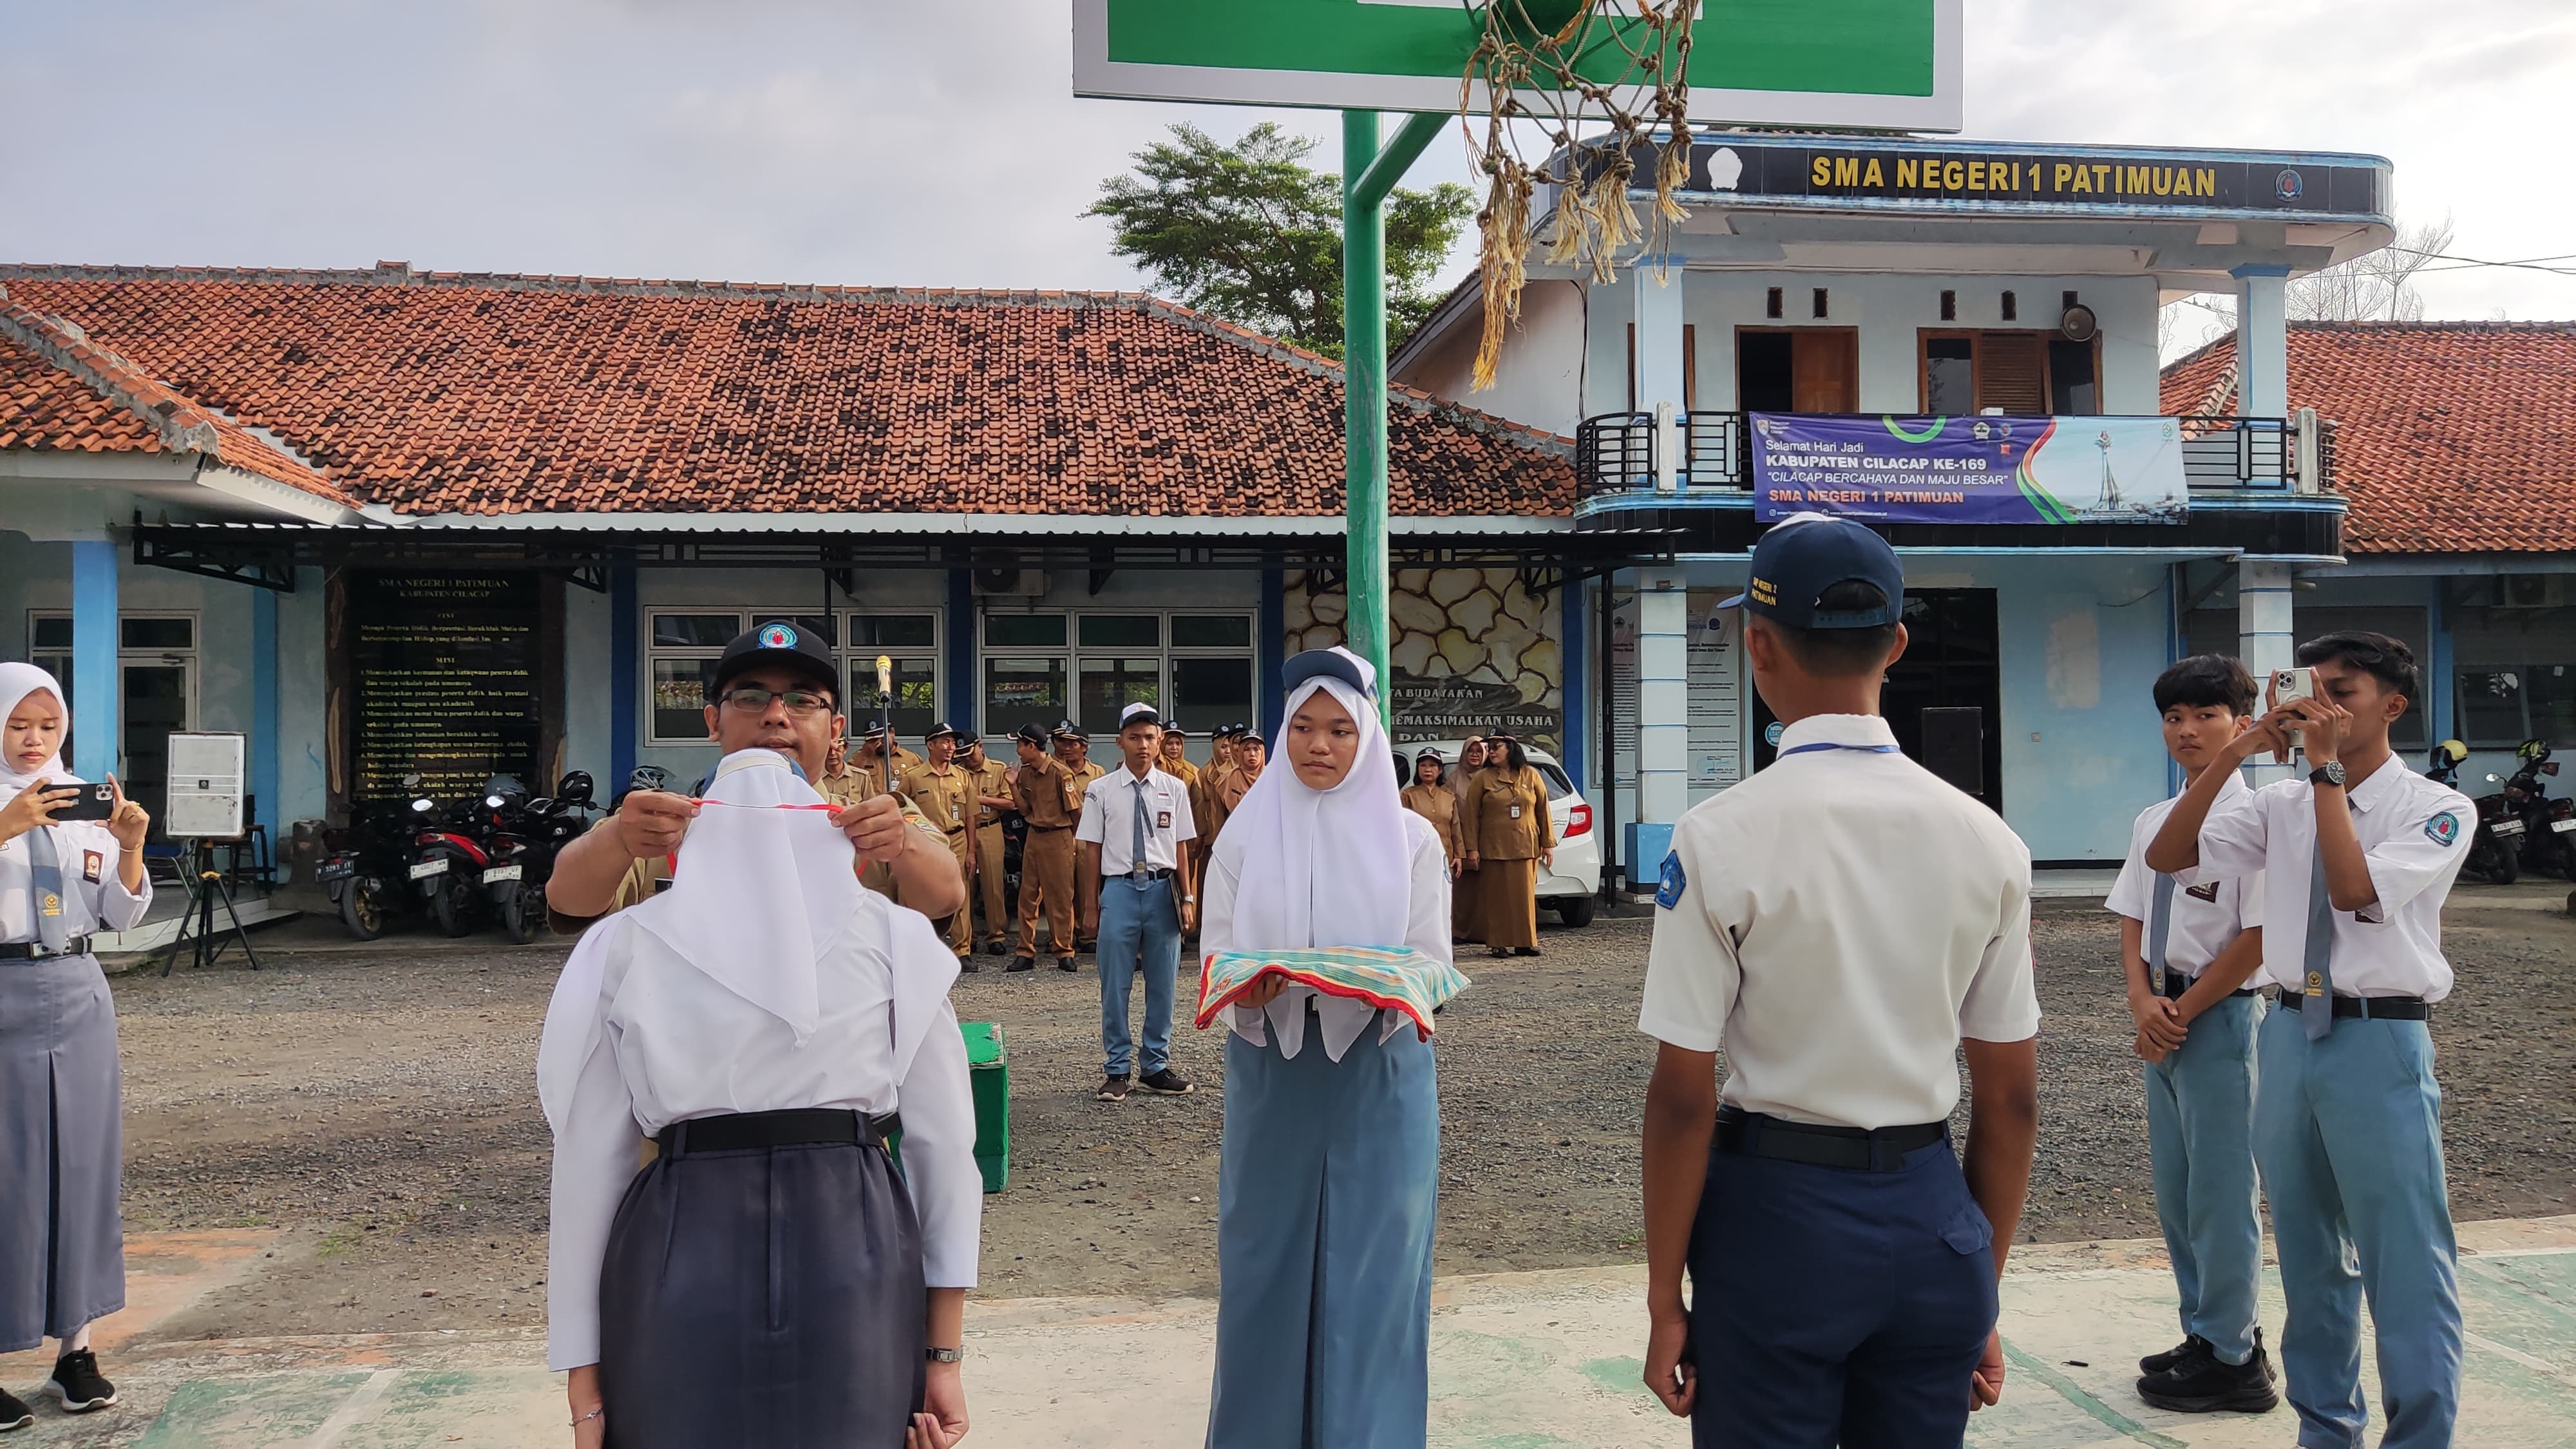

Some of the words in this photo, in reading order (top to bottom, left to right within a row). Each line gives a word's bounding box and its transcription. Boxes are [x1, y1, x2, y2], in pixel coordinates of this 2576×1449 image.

[1812, 156, 1884, 187] SMA
[1897, 159, 2020, 191] NEGERI
[2029, 164, 2040, 191] 1
[2054, 164, 2215, 196] PATIMUAN
[1766, 440, 1811, 451] Selamat
[1814, 442, 1836, 452] Hari
[1841, 442, 1864, 453] Jadi
[1766, 455, 1859, 468] KABUPATEN
[1863, 457, 1929, 469] CILACAP
[1933, 458, 1987, 470] KE-169
[1825, 473, 1897, 484] BERCAHAYA
[1900, 475, 1925, 484] DAN
[1927, 475, 1960, 484] MAJU
[1769, 490, 1803, 502] SMA
[1808, 490, 1865, 502] NEGERI
[1871, 491, 1878, 502] 1
[1884, 491, 1964, 503] PATIMUAN
[406, 579, 444, 587] NEGERI
[455, 579, 509, 587] PATIMUAN
[1752, 588, 1776, 607] PATIMUAN
[1406, 689, 1483, 699] BUDAYAKAN
[1506, 715, 1553, 726] USAHA
[1398, 733, 1439, 741] DAN
